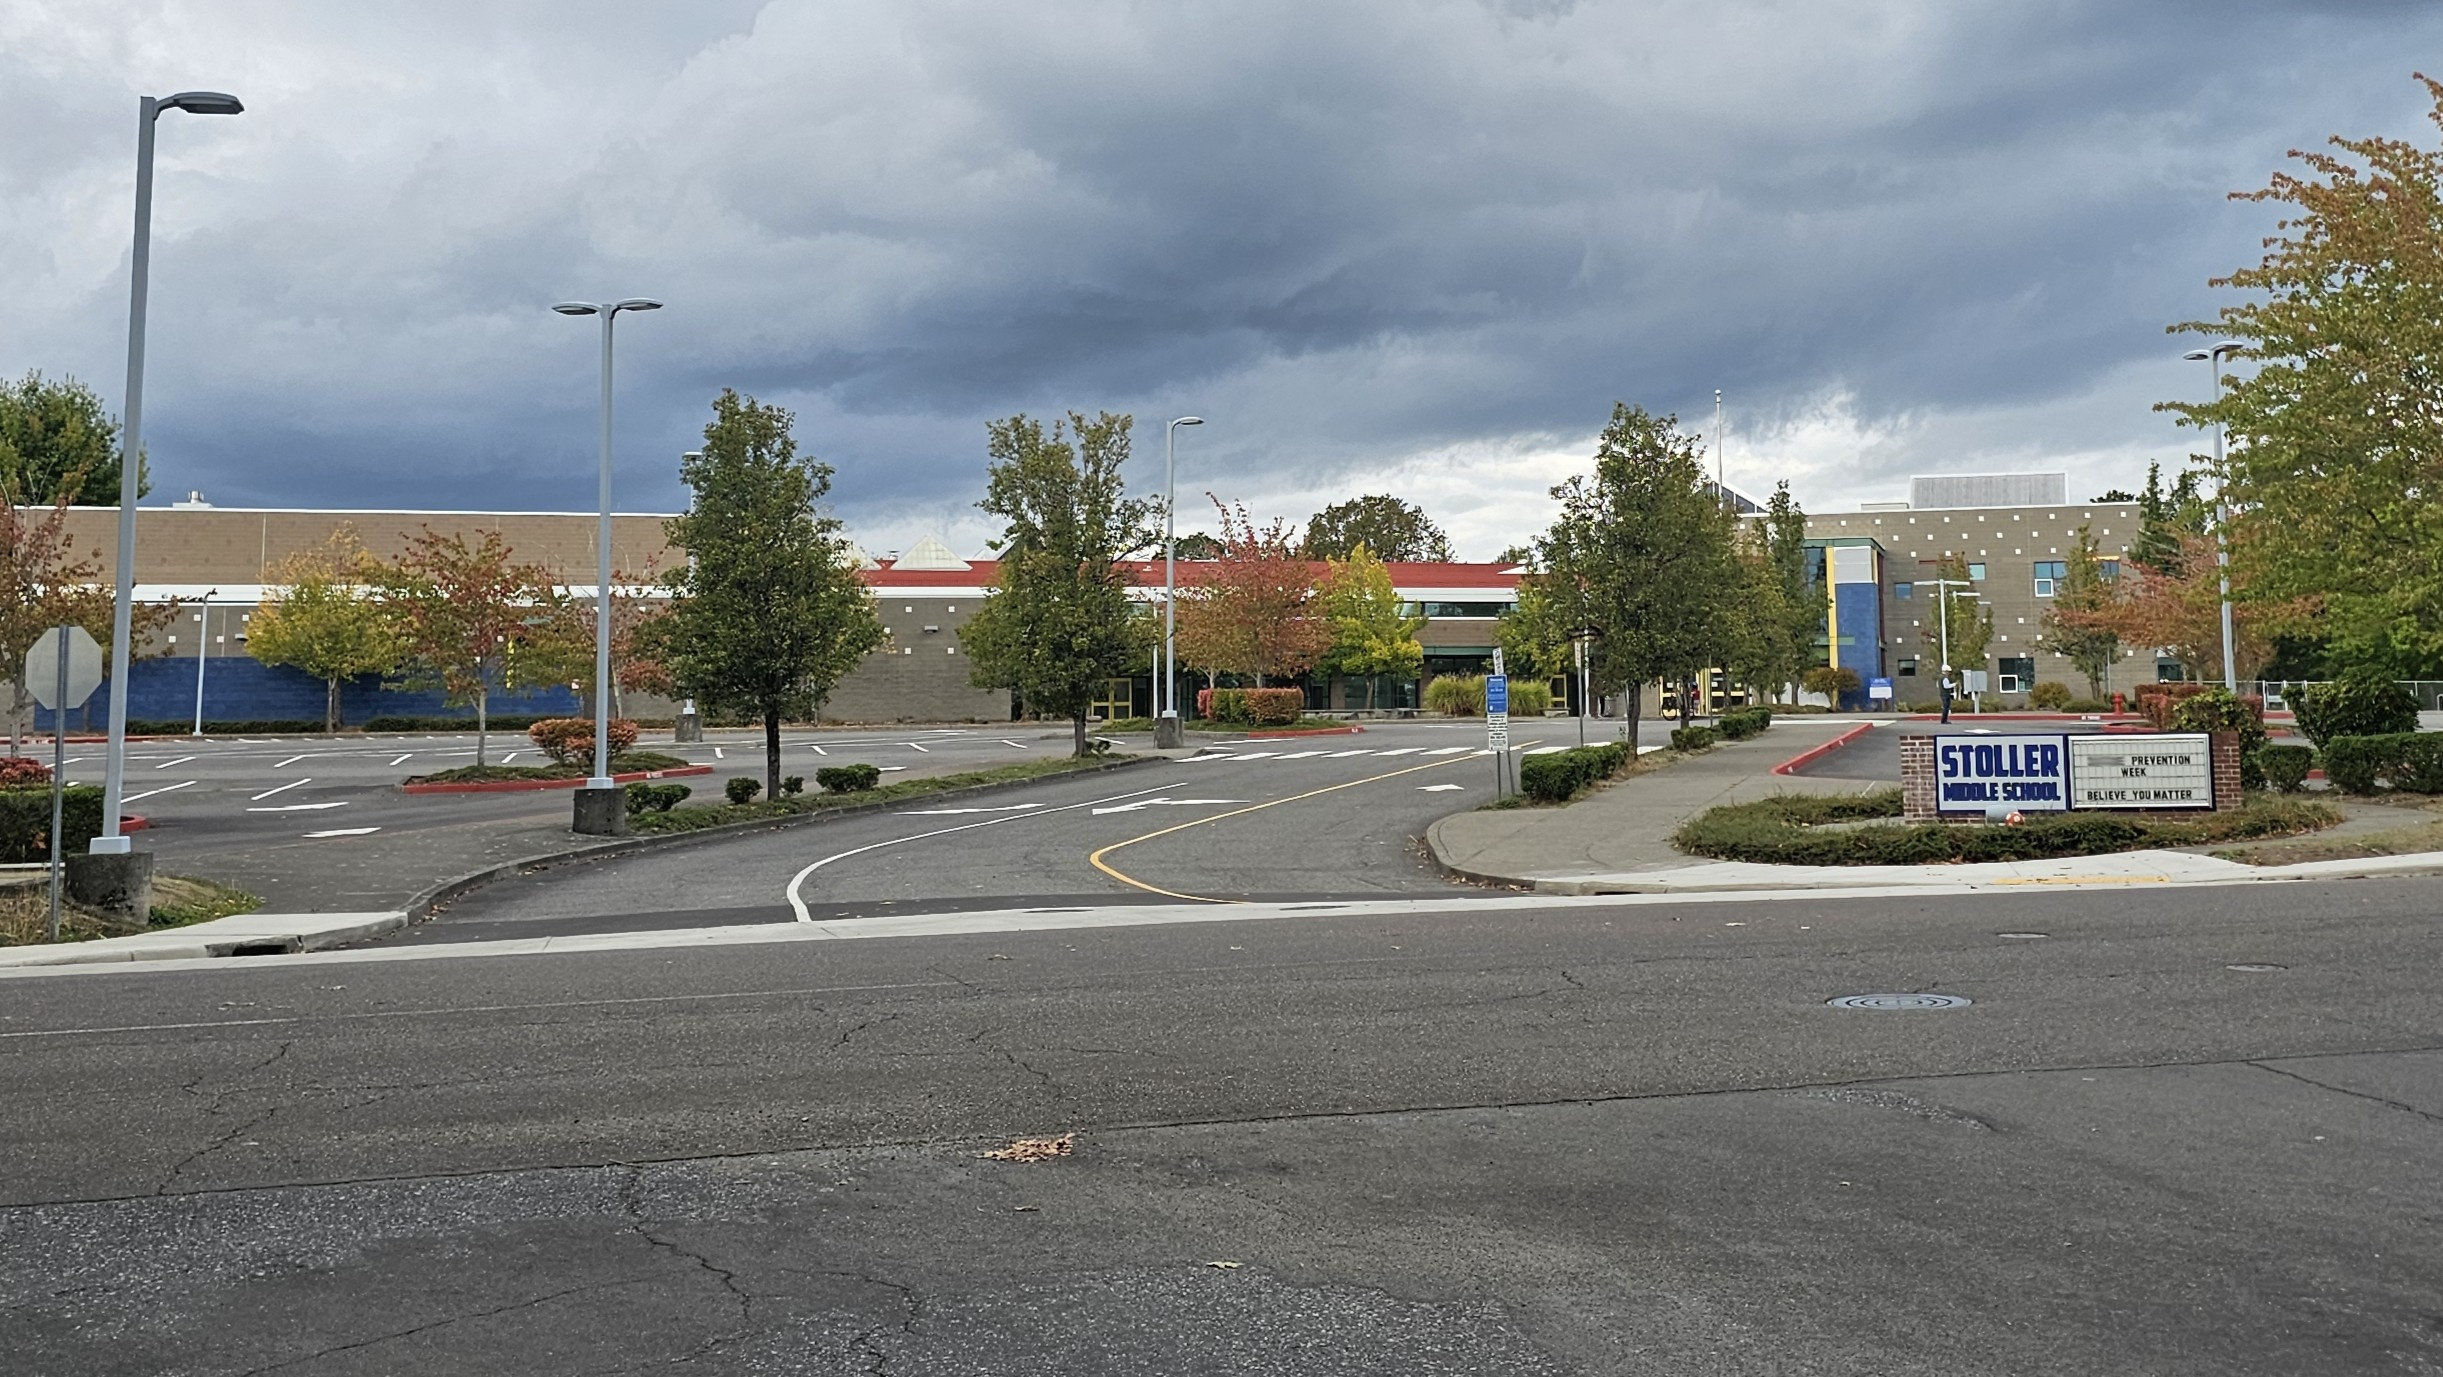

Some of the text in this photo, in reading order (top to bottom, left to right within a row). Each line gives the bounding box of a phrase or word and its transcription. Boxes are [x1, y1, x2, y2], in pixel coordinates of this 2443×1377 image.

[1941, 744, 2060, 778] STOLLER
[2131, 755, 2191, 766] PREVENTION
[2121, 767, 2147, 777] WEEK
[1943, 782, 2061, 801] MIDDLE SCHOOL
[2087, 790, 2192, 800] BELIEVE YOU MATTER
